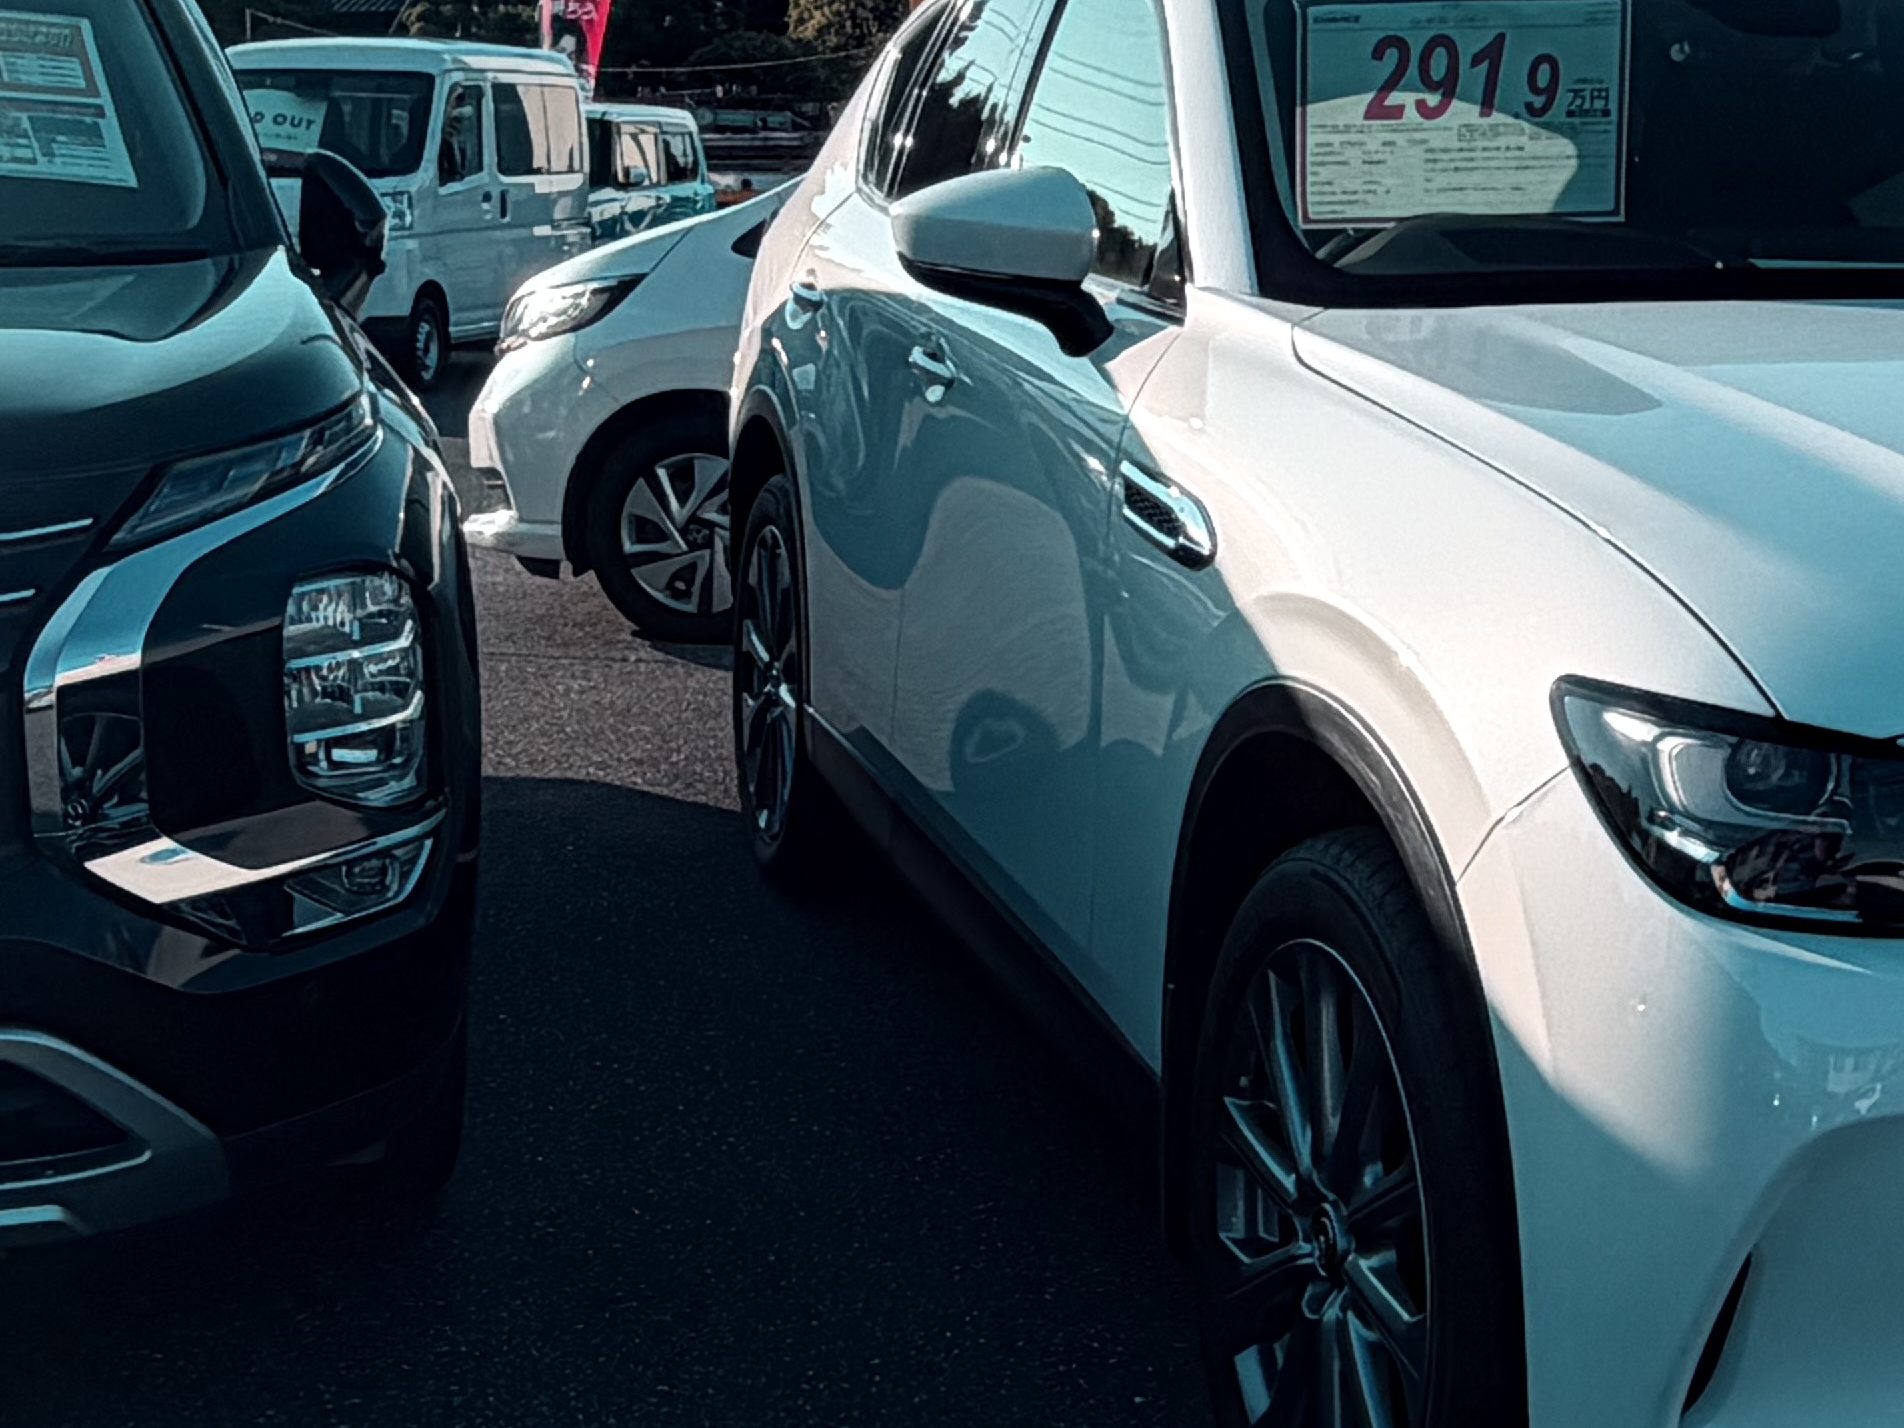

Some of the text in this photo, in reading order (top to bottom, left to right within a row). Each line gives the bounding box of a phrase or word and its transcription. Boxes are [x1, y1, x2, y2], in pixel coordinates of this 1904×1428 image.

[1363, 31, 1609, 121] 291.9 万円
[273, 113, 315, 130] OUT
